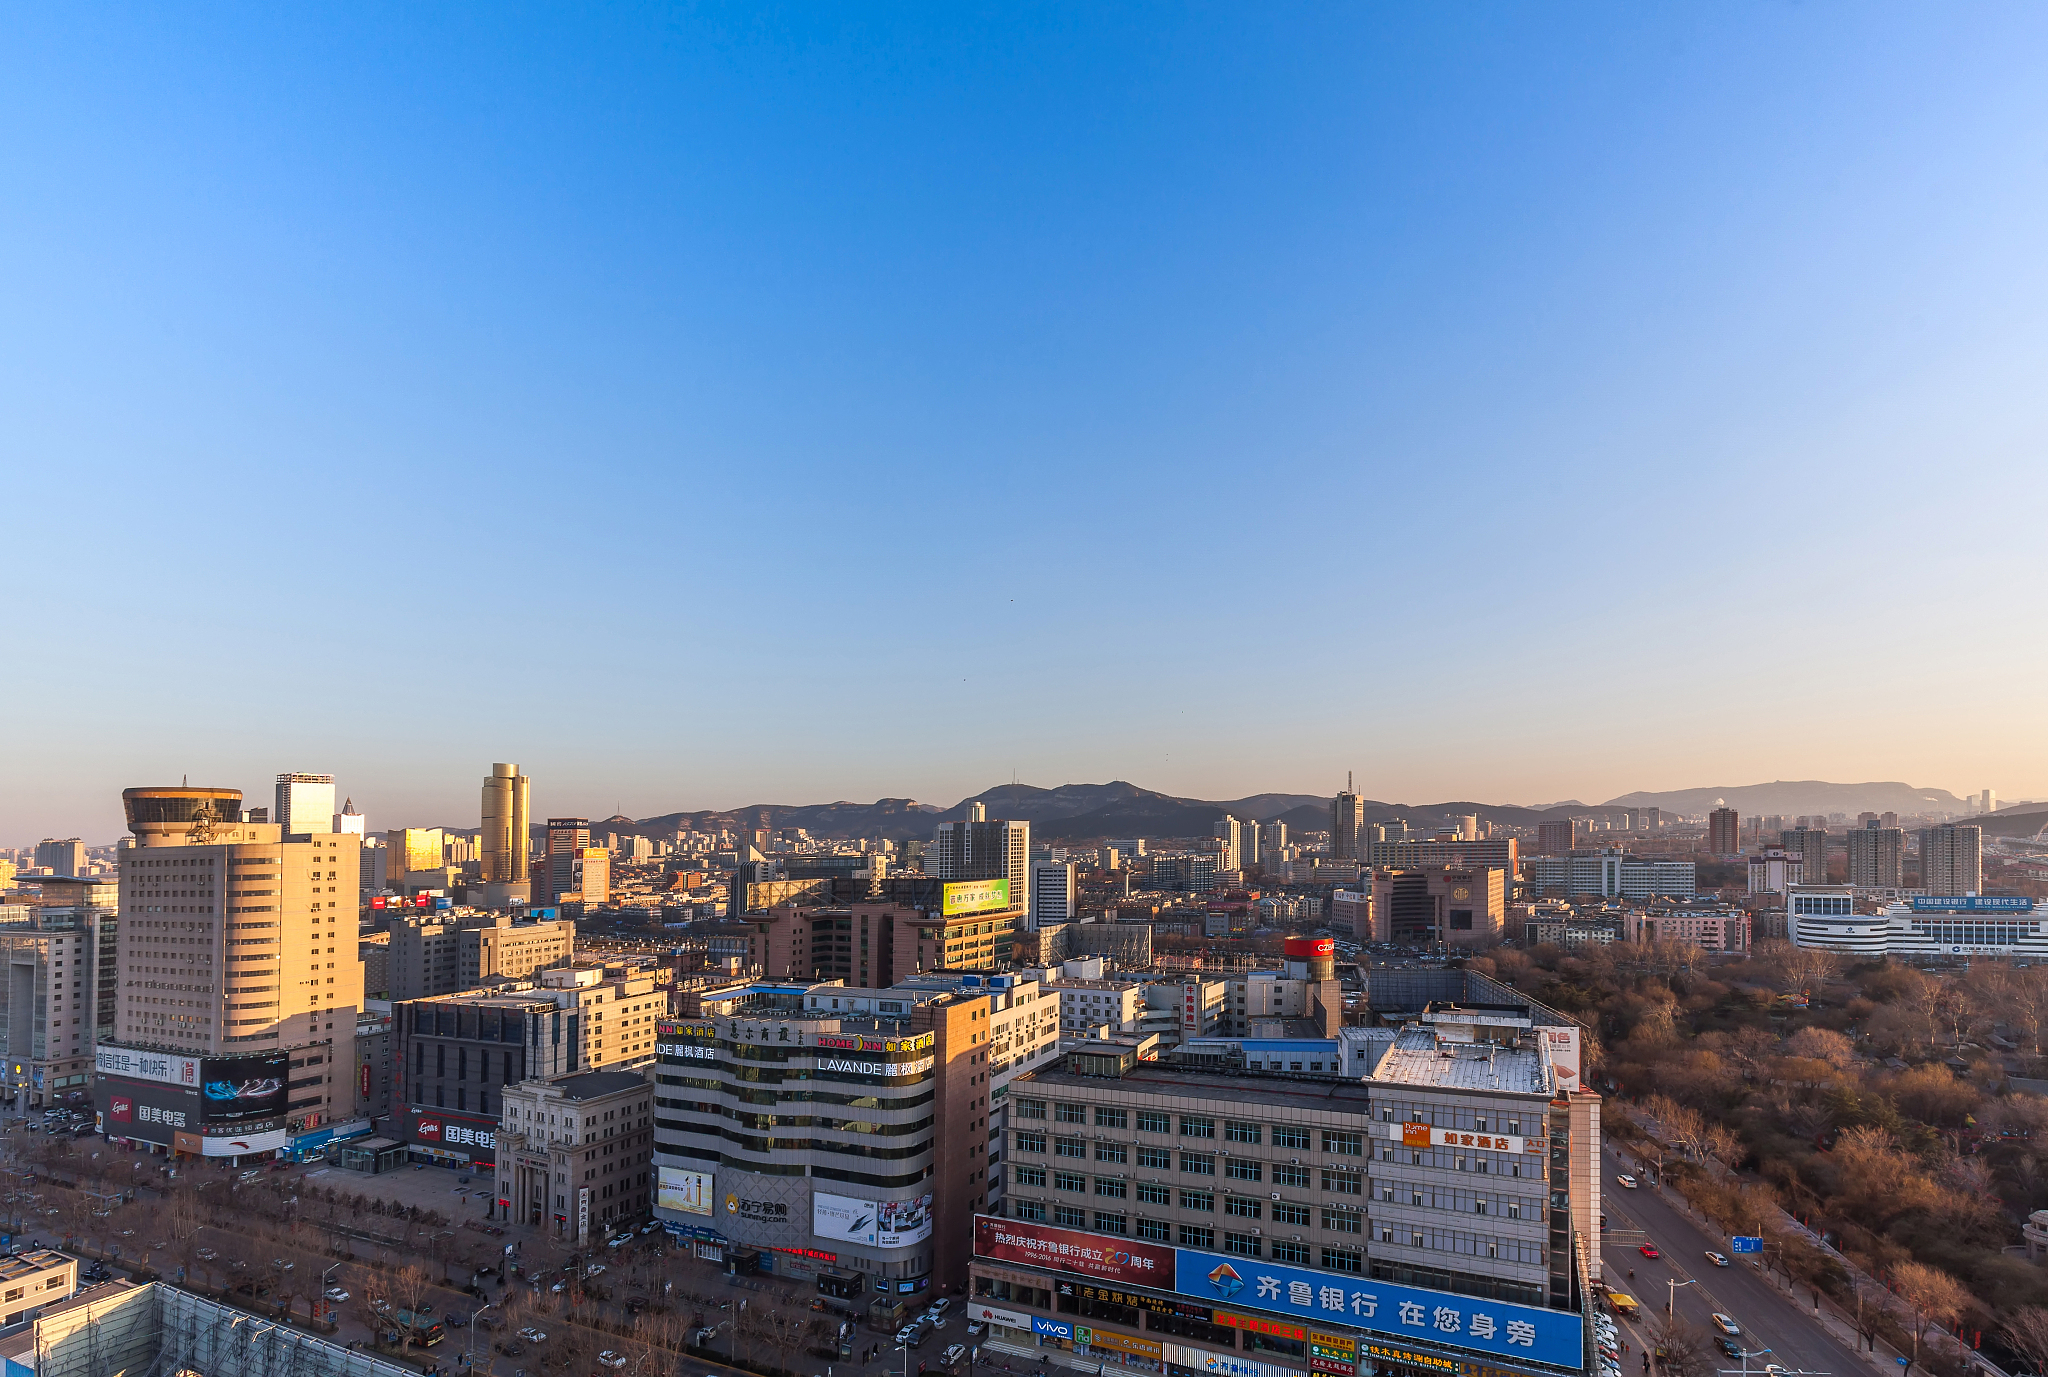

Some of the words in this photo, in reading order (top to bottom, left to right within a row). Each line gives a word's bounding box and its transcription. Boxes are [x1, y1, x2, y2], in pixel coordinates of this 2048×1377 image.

[1974, 898, 2028, 906] 建设现代生活
[818, 1038, 854, 1049] HOME
[885, 1034, 933, 1052] 如家酒店
[818, 1058, 882, 1076] LAVANDE
[138, 1105, 186, 1128] 国美电器
[1405, 1122, 1428, 1131] home
[1444, 1132, 1509, 1150] 如家酒店
[1526, 1138, 1545, 1148] 入口
[741, 1198, 787, 1217] 苏宁易购
[1024, 1251, 1052, 1262] 1996-2016
[994, 1314, 1017, 1324] HUAWEI
[1256, 1275, 1379, 1319] 齐鲁银行
[1398, 1300, 1537, 1348] 在您身旁
[1037, 1321, 1068, 1335] vivo
